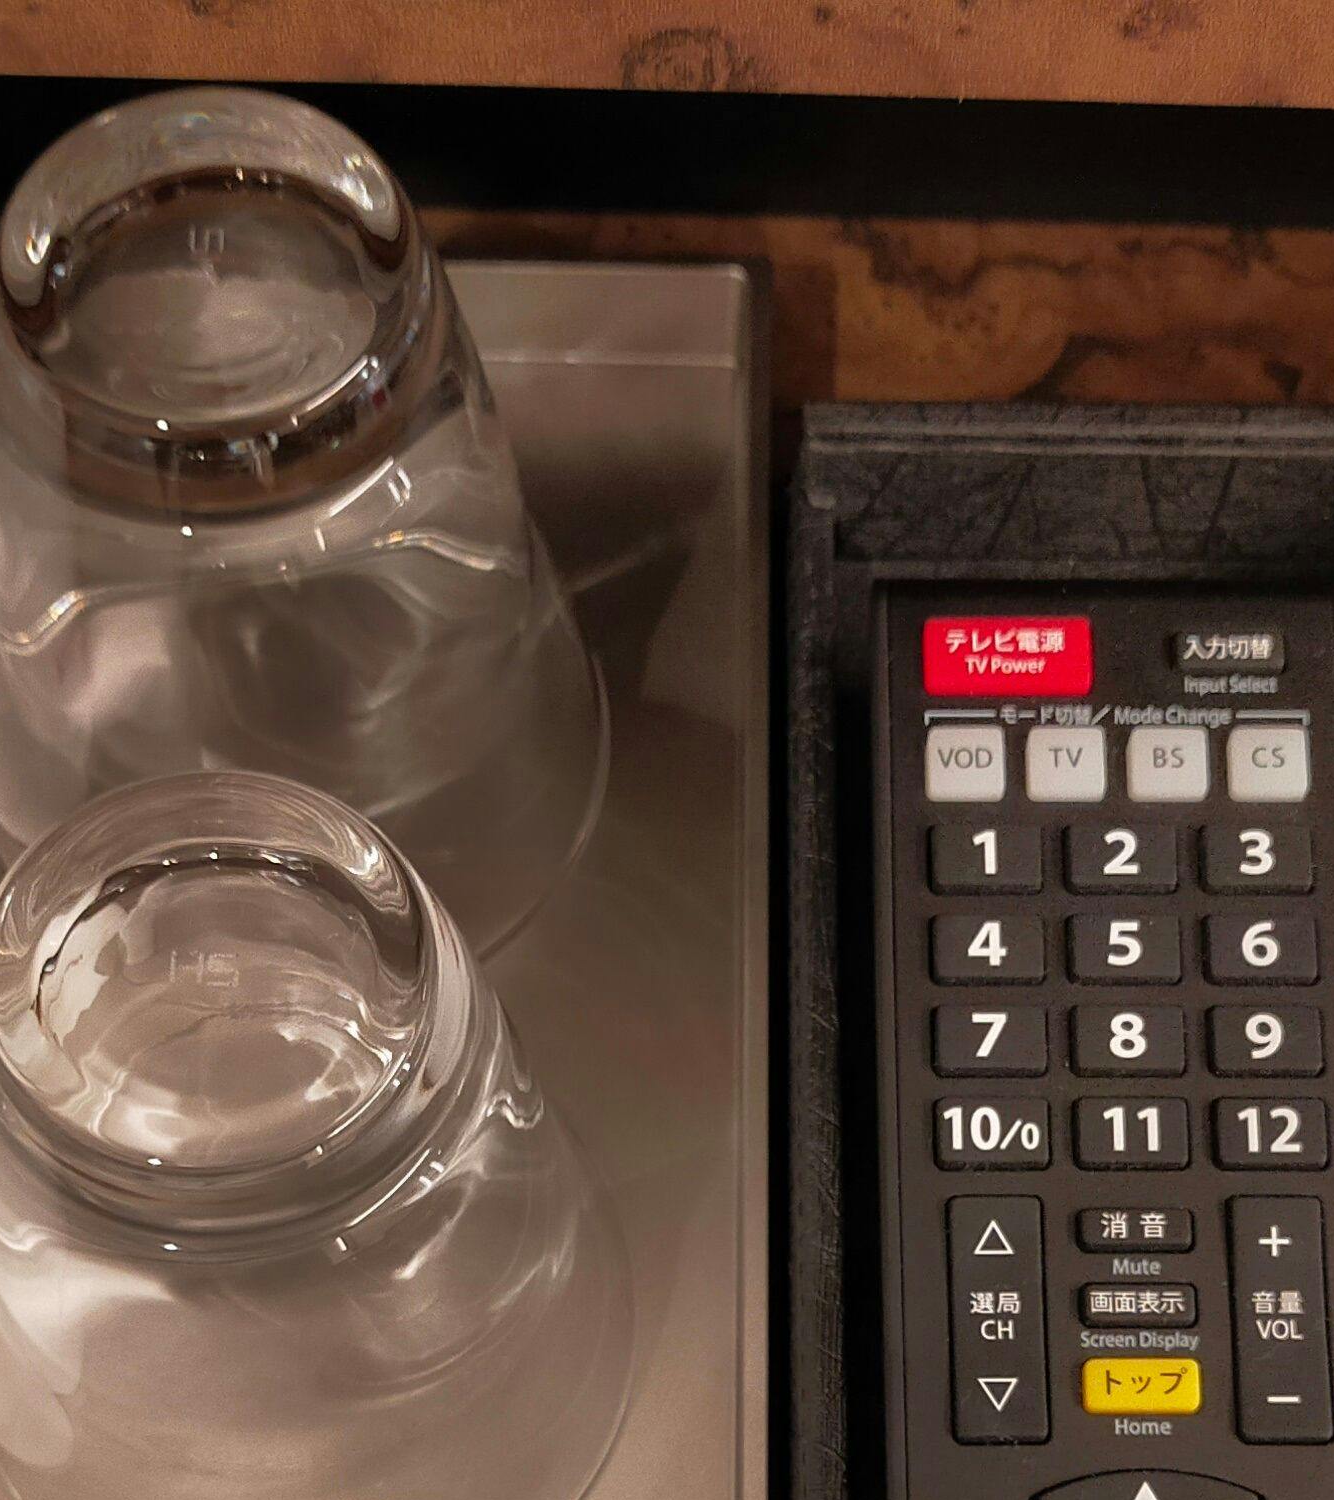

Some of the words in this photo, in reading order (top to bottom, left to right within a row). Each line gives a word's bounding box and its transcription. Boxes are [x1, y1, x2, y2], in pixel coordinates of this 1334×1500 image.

[946, 627, 1065, 654] テレビ電源
[1183, 634, 1272, 660] 入力切替
[965, 657, 988, 674] TV
[990, 656, 1046, 674] Power
[1184, 676, 1226, 697] Input
[1229, 675, 1278, 694] Select
[1165, 704, 1232, 727] Change
[938, 747, 993, 769] VOD
[1049, 747, 1083, 768] TV
[1153, 748, 1185, 769] BS
[1251, 746, 1285, 769] CS
[972, 829, 998, 875] 1
[1103, 830, 1140, 875] 2
[1239, 829, 1274, 876] 3
[968, 921, 1007, 966] 4
[1107, 921, 1142, 966] 5
[1242, 921, 1280, 967] 6
[971, 1012, 1008, 1058] 7
[1108, 1013, 1147, 1059] 8
[1245, 1014, 1284, 1060] 9
[943, 1106, 1040, 1152] 10/0
[1103, 1106, 1162, 1152] 11
[1237, 1108, 1302, 1153] 12
[1112, 1258, 1162, 1276] Mute
[969, 1291, 1021, 1316] 選局
[1089, 1290, 1185, 1315] 画面表示
[1251, 1290, 1304, 1315] 音量
[980, 1319, 1015, 1341] CH
[1080, 1331, 1136, 1350] Screen
[1138, 1331, 1200, 1352] Display
[1256, 1319, 1304, 1341] VOL
[1104, 1366, 1188, 1396] トップ
[1114, 1418, 1173, 1437] Home
